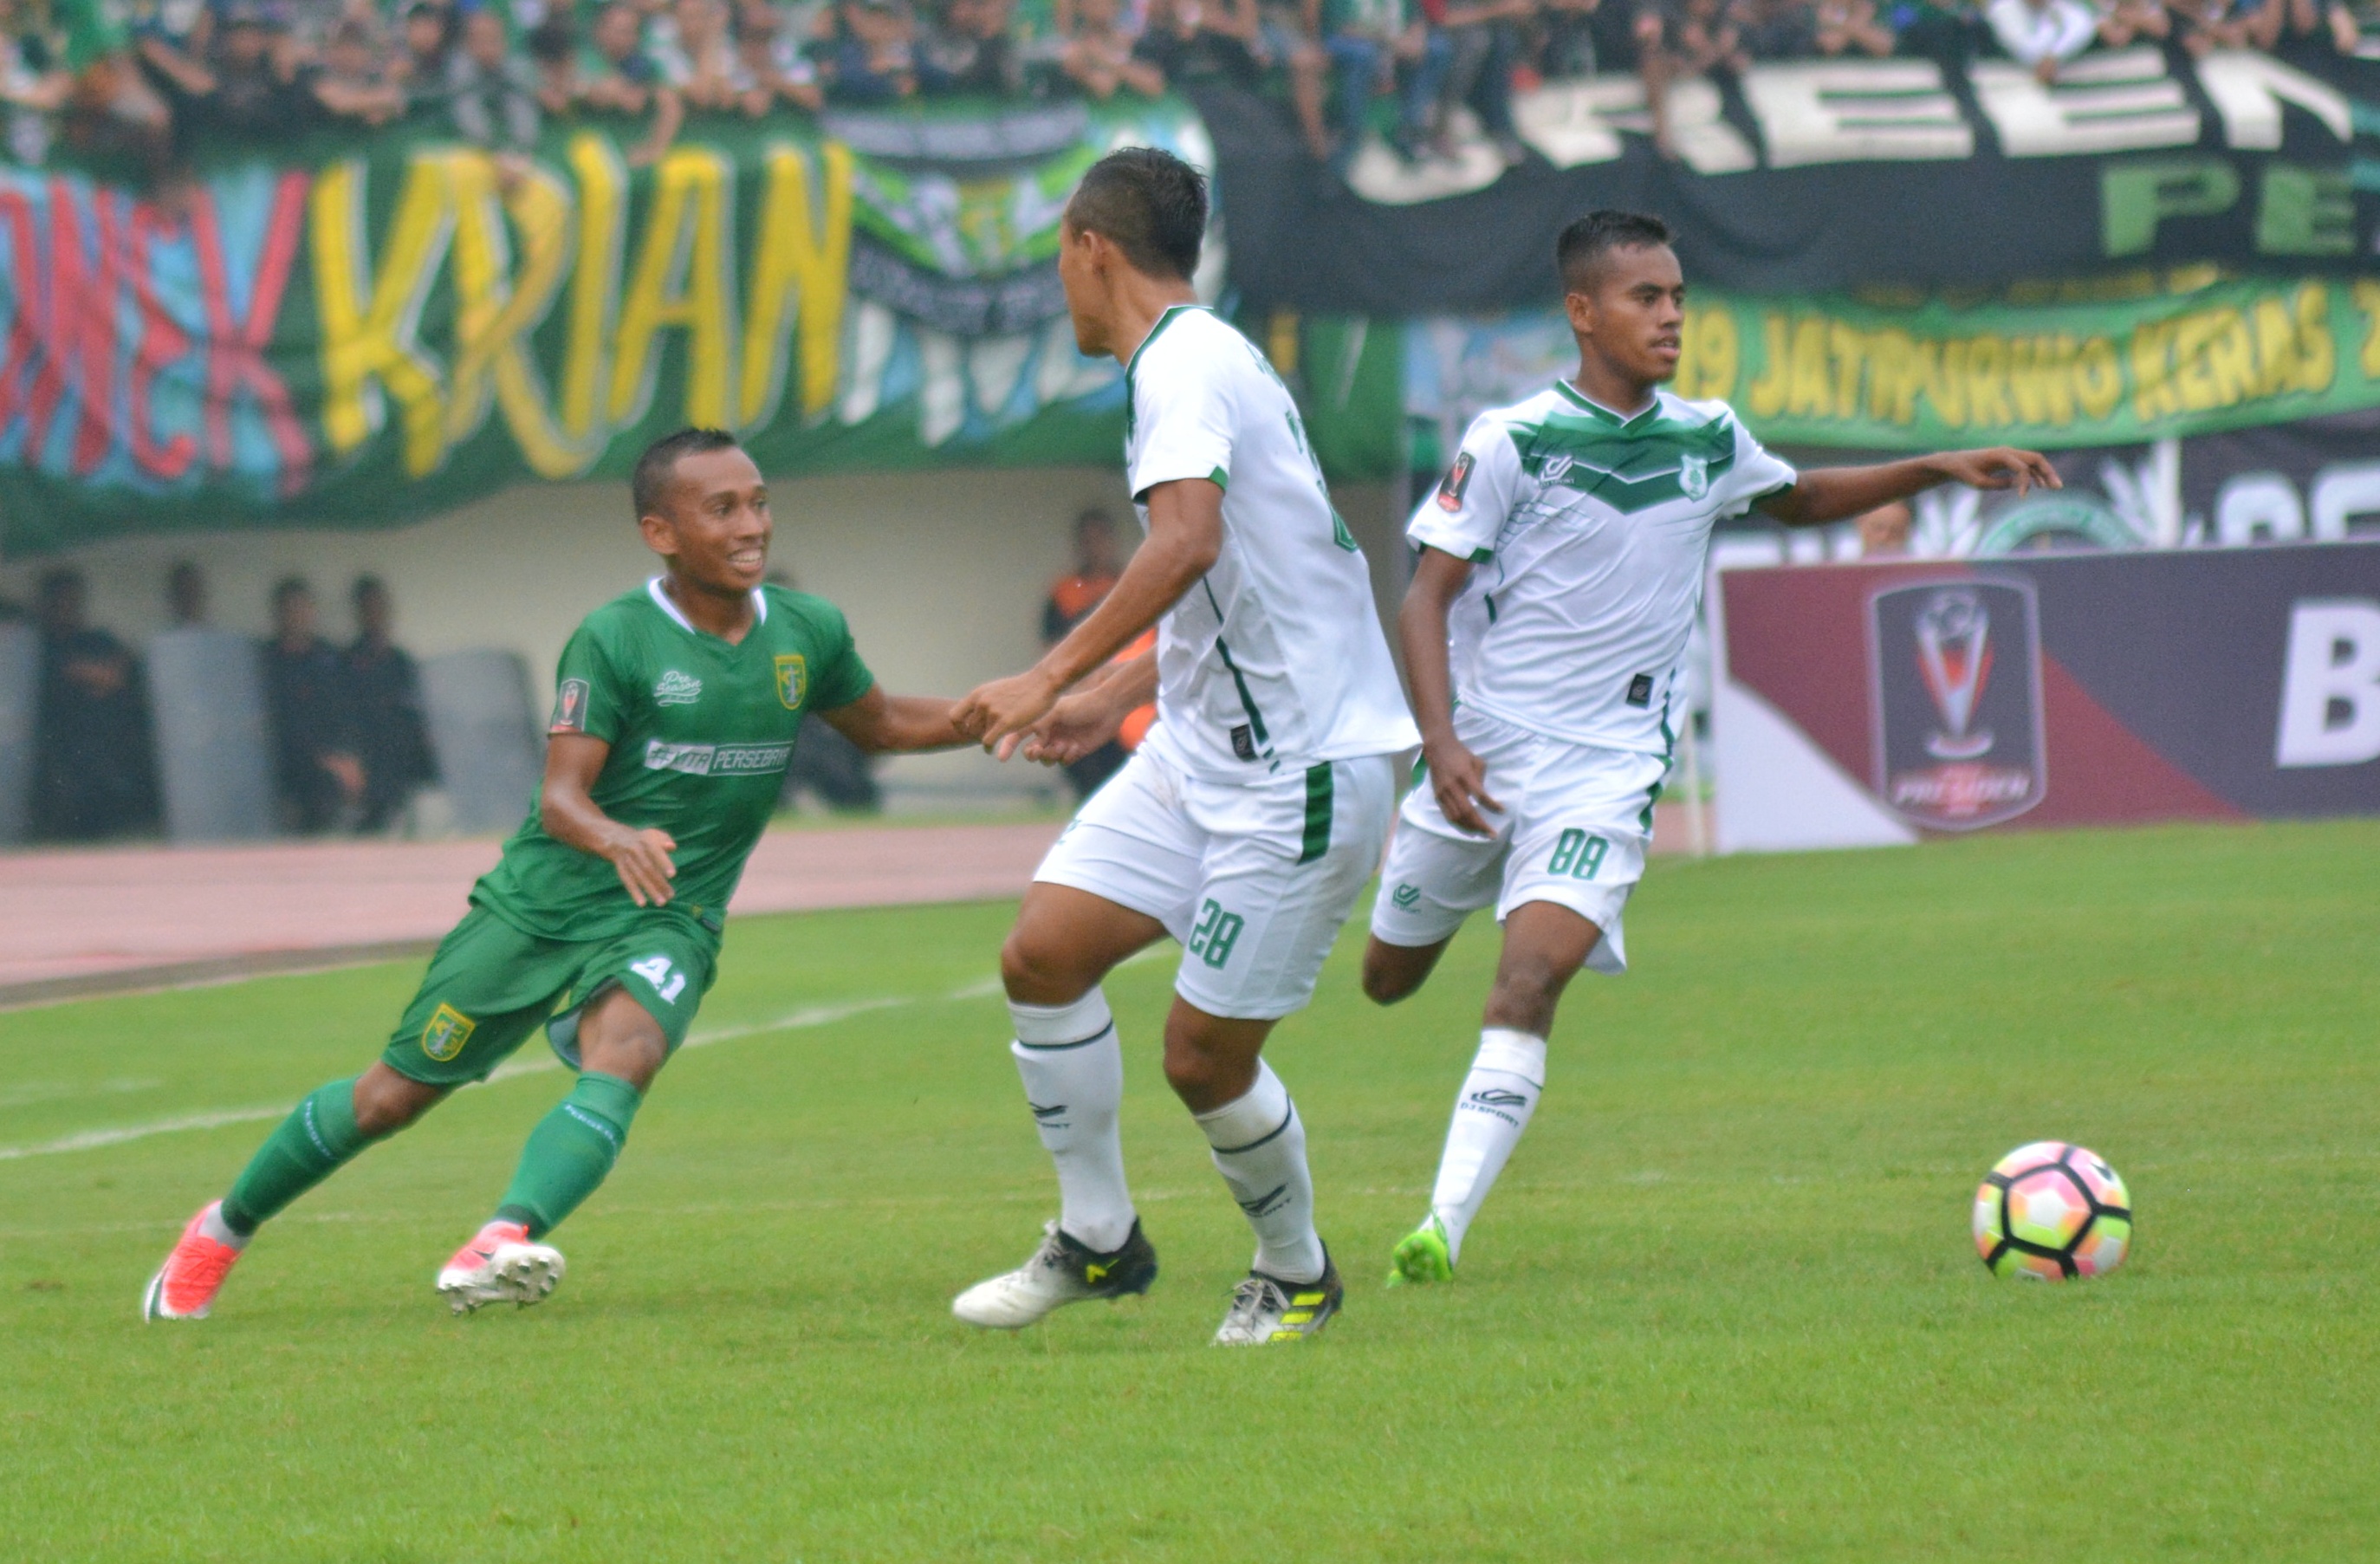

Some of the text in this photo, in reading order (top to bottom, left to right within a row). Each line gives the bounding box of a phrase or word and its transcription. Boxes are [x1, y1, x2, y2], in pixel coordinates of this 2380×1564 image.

[312, 131, 853, 482] KRIAN
[2130, 278, 2335, 422] KERAS
[1547, 827, 1610, 881] 88
[1189, 898, 1245, 970] 28
[630, 954, 686, 1006] 41
